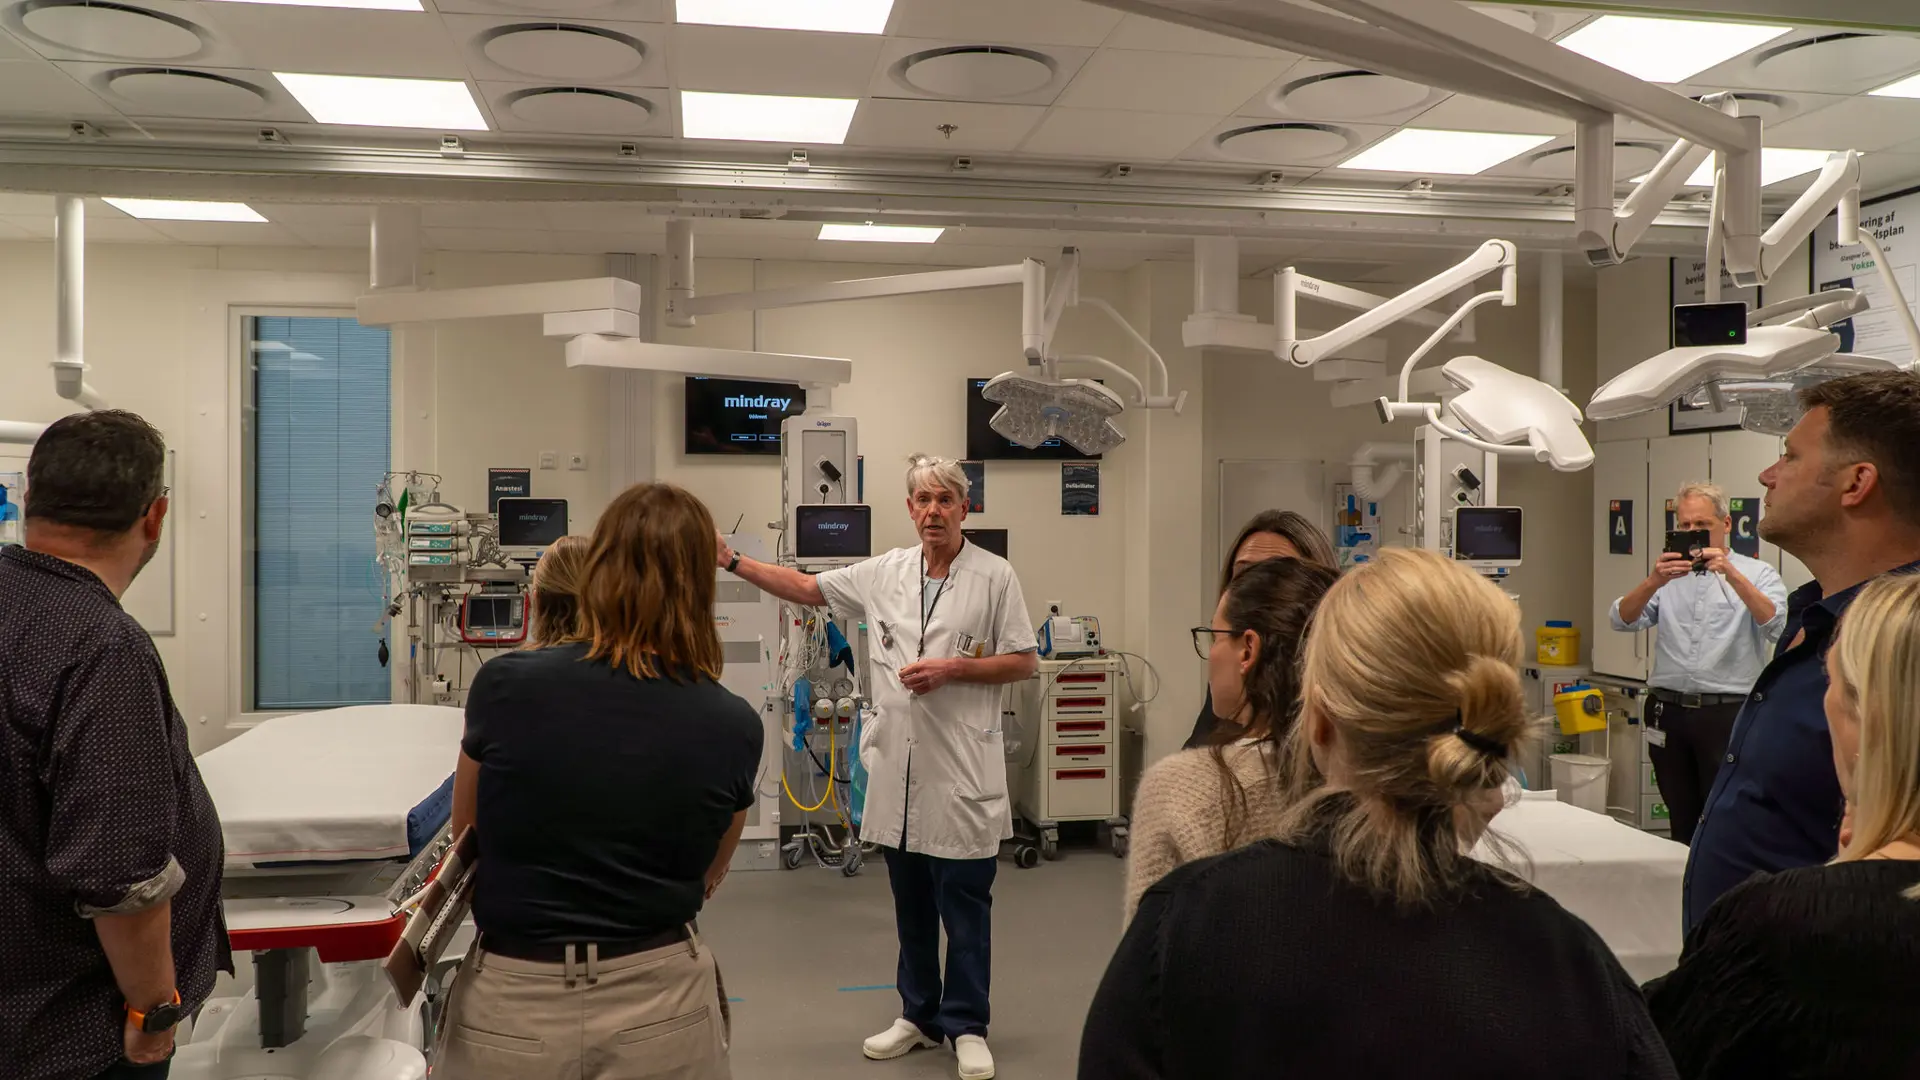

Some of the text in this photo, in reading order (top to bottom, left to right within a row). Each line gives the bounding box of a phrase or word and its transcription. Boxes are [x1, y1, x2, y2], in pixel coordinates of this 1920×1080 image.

[1884, 211, 1896, 223] af
[1851, 260, 1875, 271] Voksn
[724, 394, 791, 412] mindray
[518, 514, 548, 522] mindray
[818, 522, 849, 531] mindray
[1615, 515, 1627, 536] A
[1738, 515, 1751, 538] C
